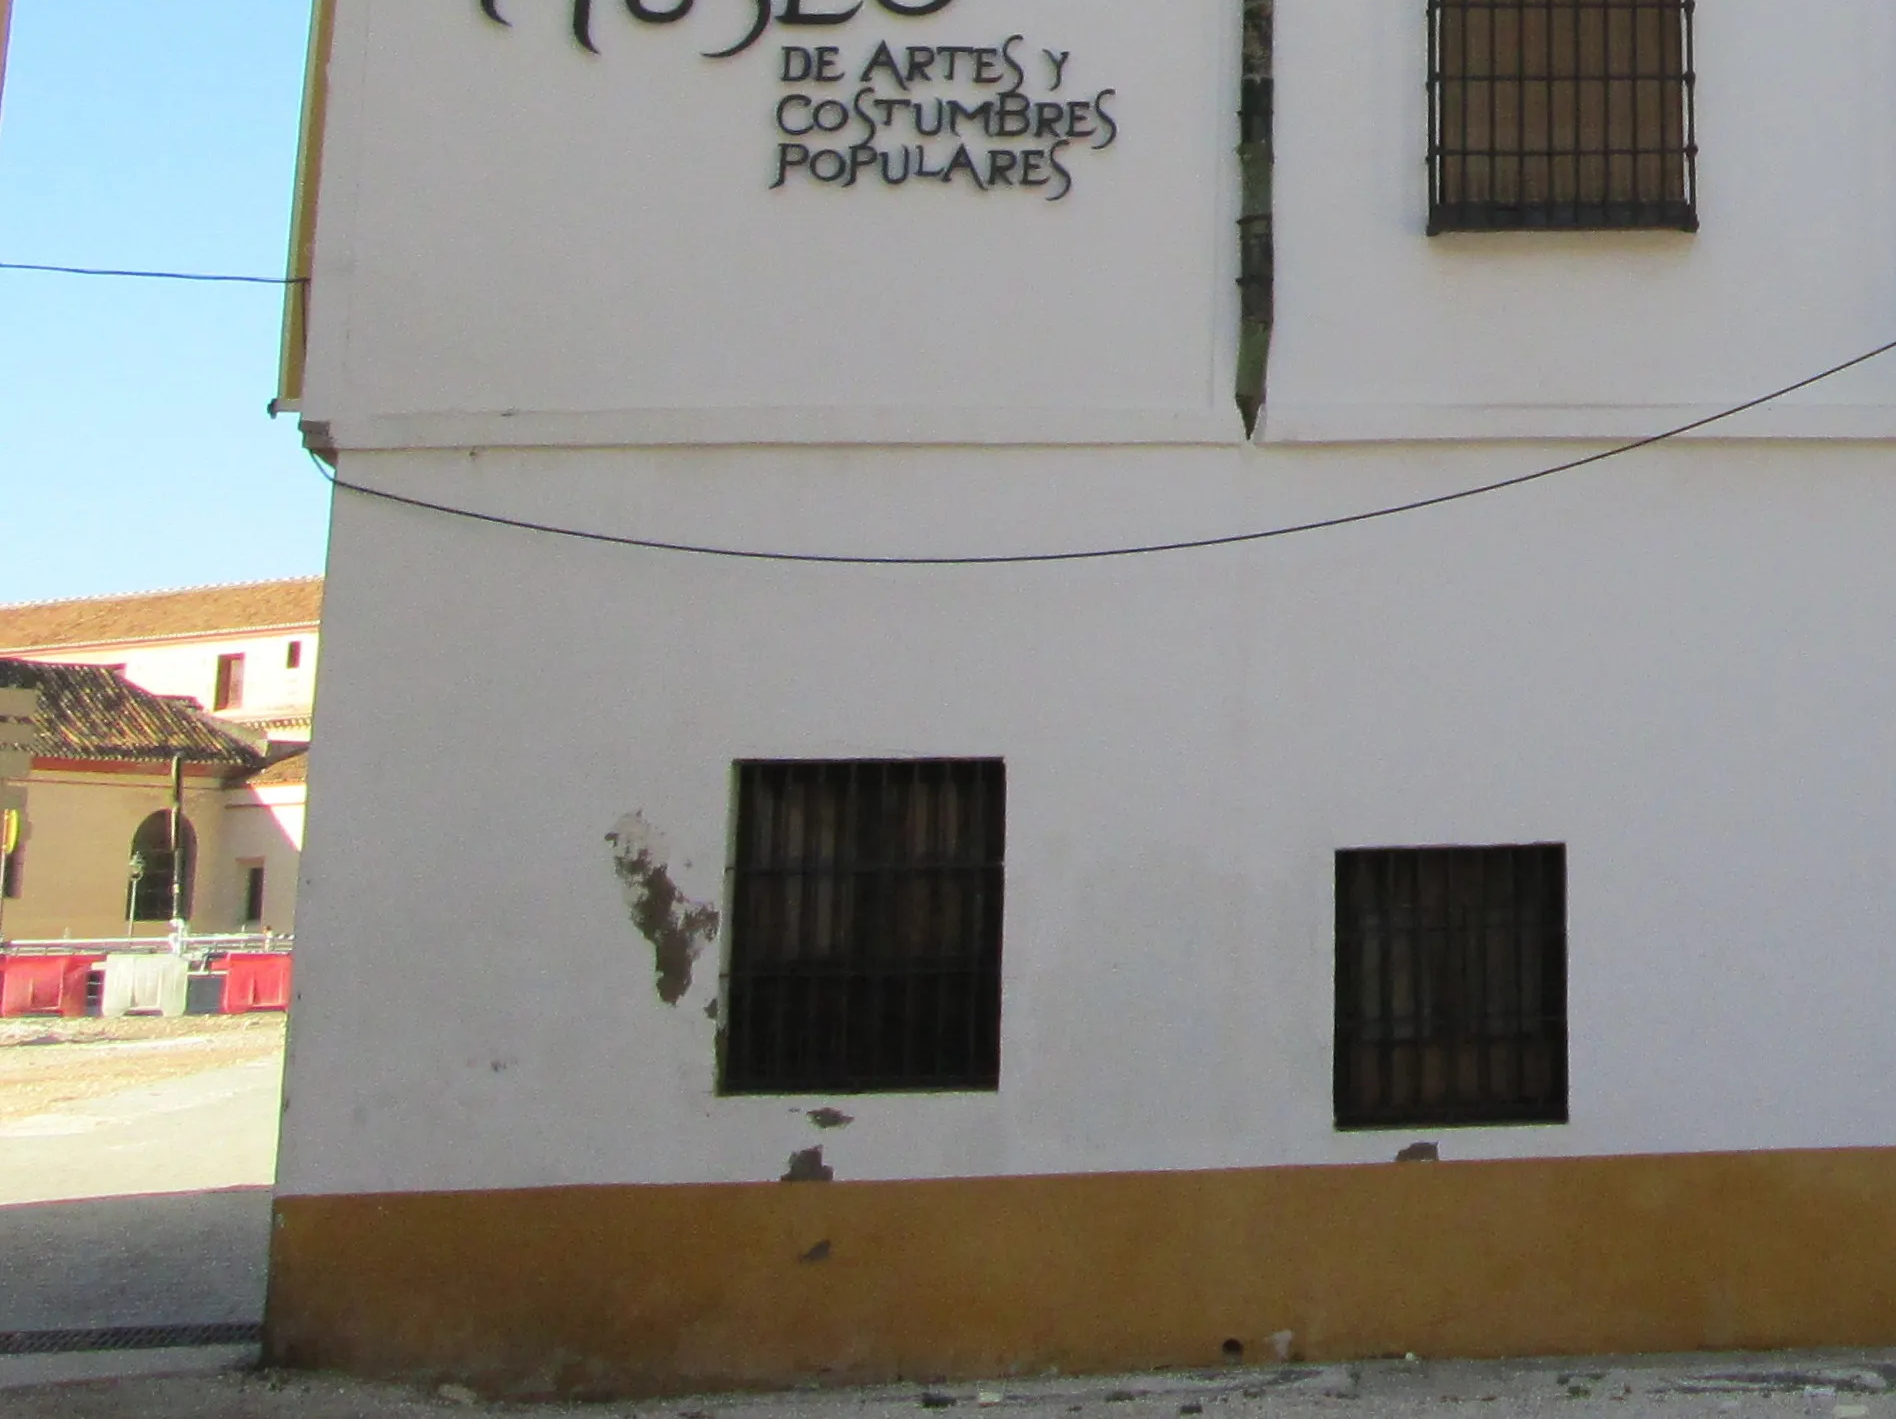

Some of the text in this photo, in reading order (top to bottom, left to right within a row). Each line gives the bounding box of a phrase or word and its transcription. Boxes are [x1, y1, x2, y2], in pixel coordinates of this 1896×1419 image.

[780, 34, 1071, 92] DE ARTES Y
[775, 87, 1118, 150] COSTUMBRES
[768, 138, 1072, 202] POPULARES
